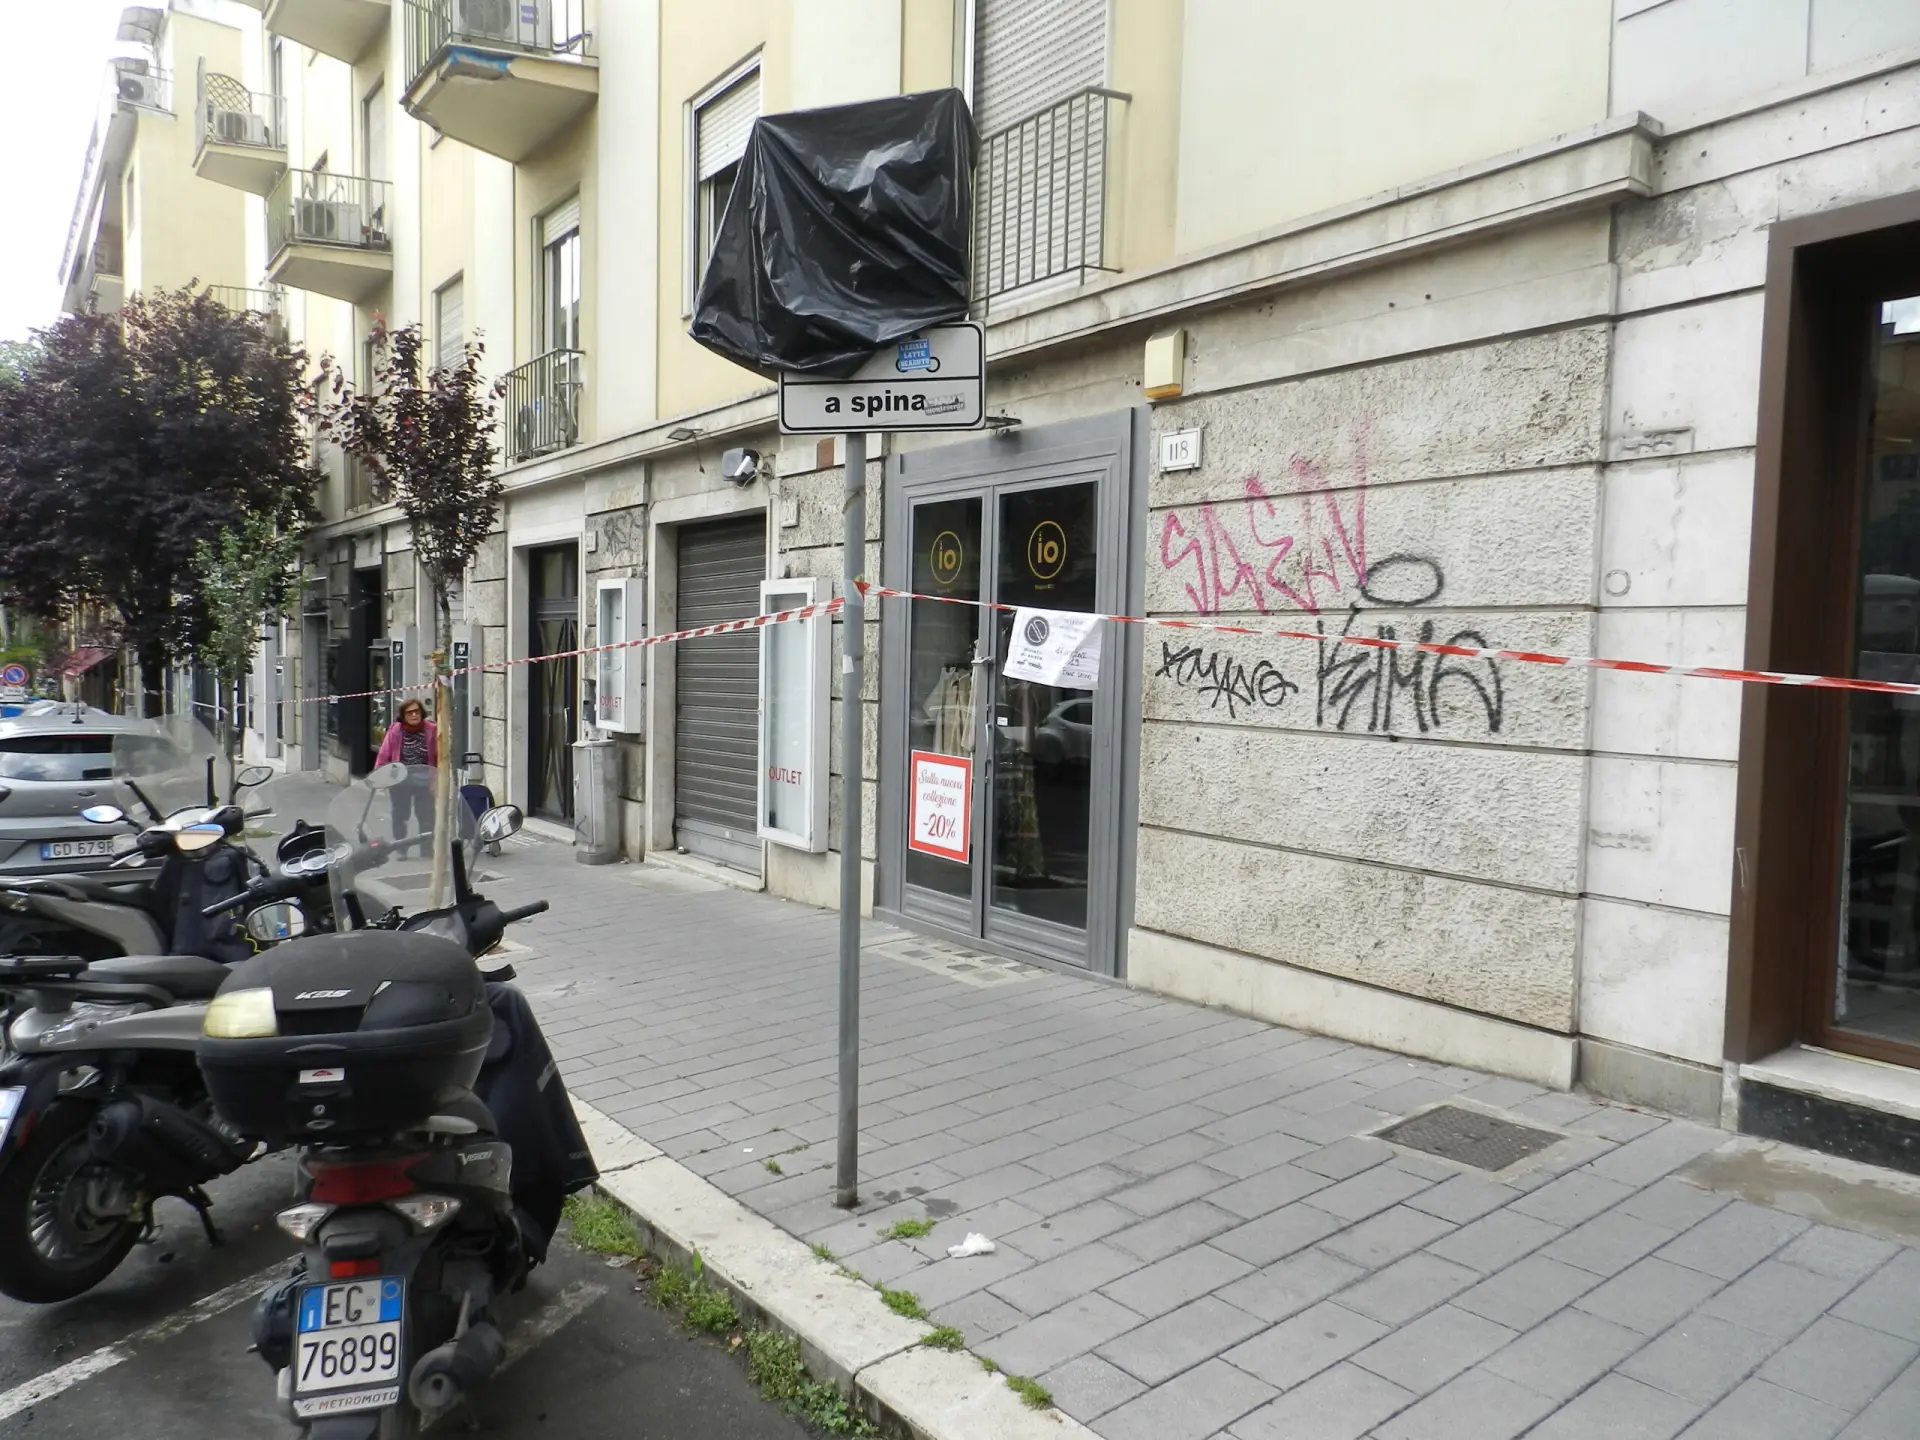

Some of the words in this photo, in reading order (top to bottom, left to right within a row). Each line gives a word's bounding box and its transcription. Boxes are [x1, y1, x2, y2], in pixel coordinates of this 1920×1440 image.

[824, 396, 841, 414] a
[851, 389, 926, 418] spina
[1169, 440, 1189, 461] 118
[600, 695, 622, 708] OUTLET
[768, 766, 802, 786] OUTLET
[922, 790, 957, 808] collezione
[923, 813, 956, 839] -20%
[326, 1285, 364, 1326] EG
[302, 1331, 397, 1382] 76899
[318, 1391, 398, 1411] METROMOTO
